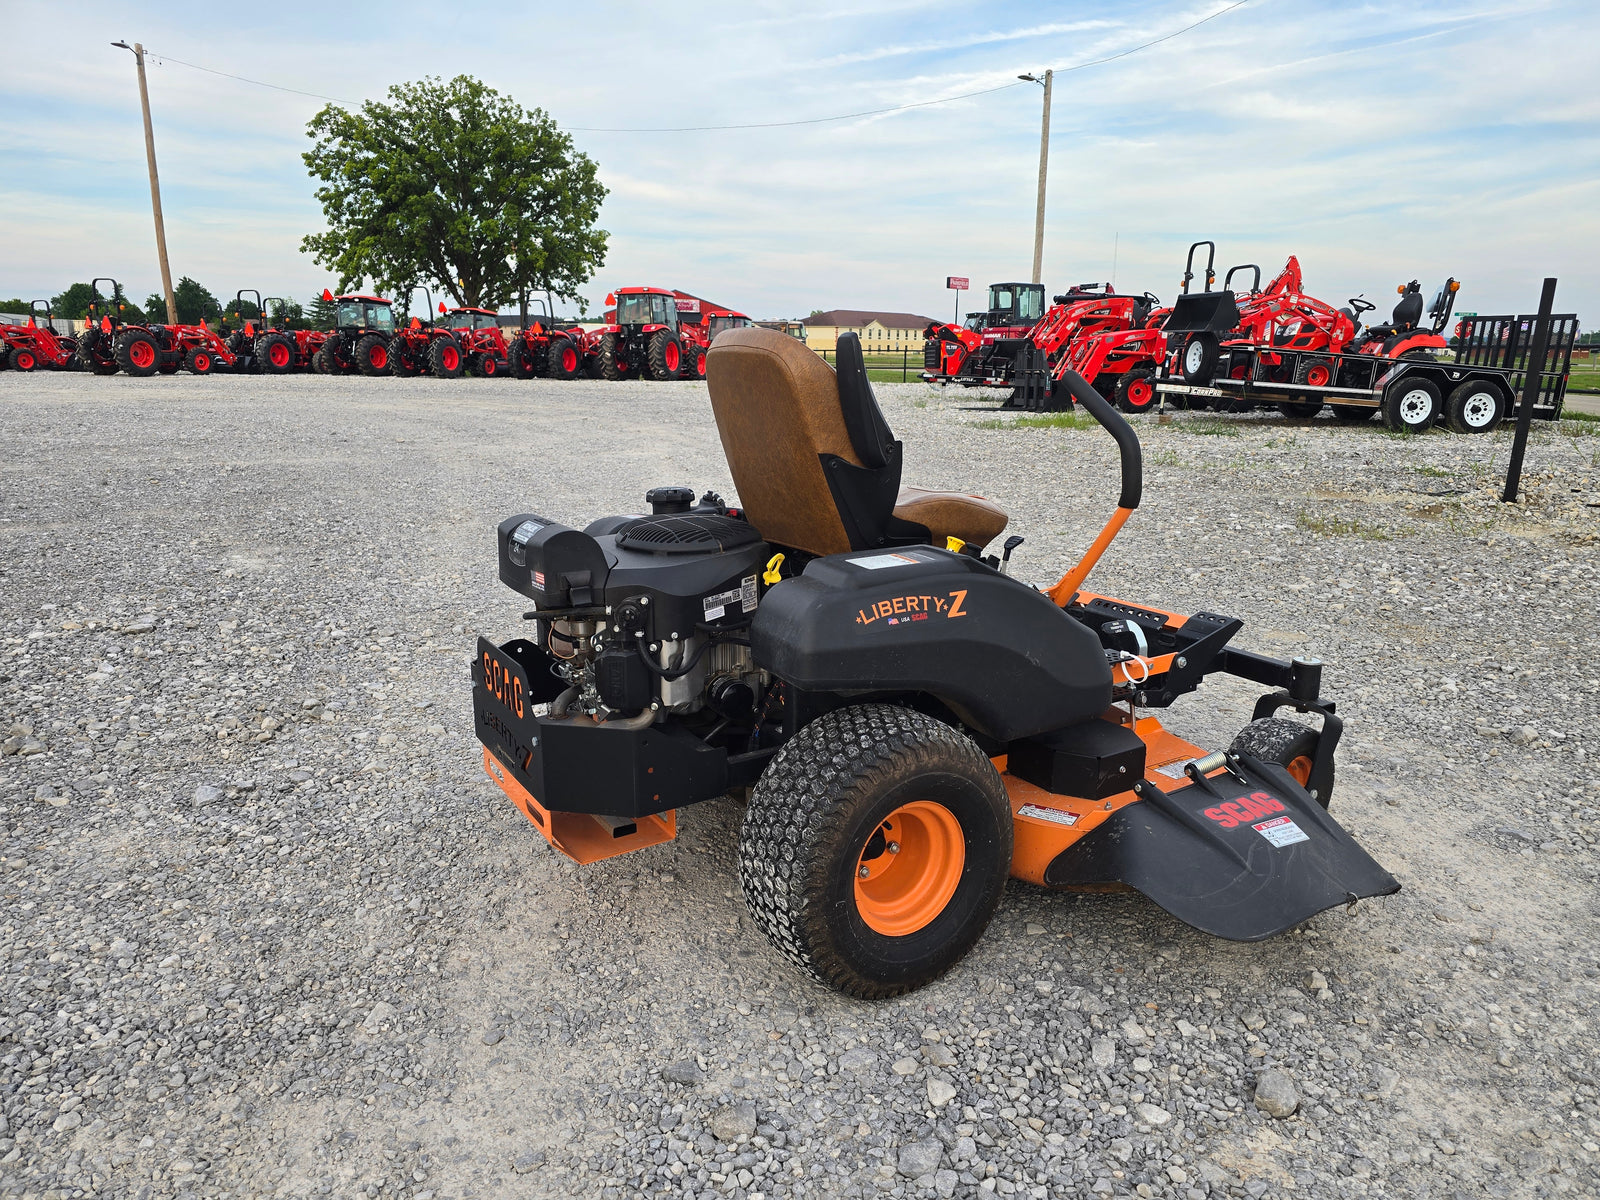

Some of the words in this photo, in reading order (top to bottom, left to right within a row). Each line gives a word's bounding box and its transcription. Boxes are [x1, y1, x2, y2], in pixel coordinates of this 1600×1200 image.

[1455, 326, 1472, 334] SP
[859, 595, 946, 625] LIBERTY
[947, 589, 968, 618] Z
[911, 612, 928, 622] SCAG
[483, 651, 524, 719] SCAG
[1203, 792, 1285, 828] SCAG
